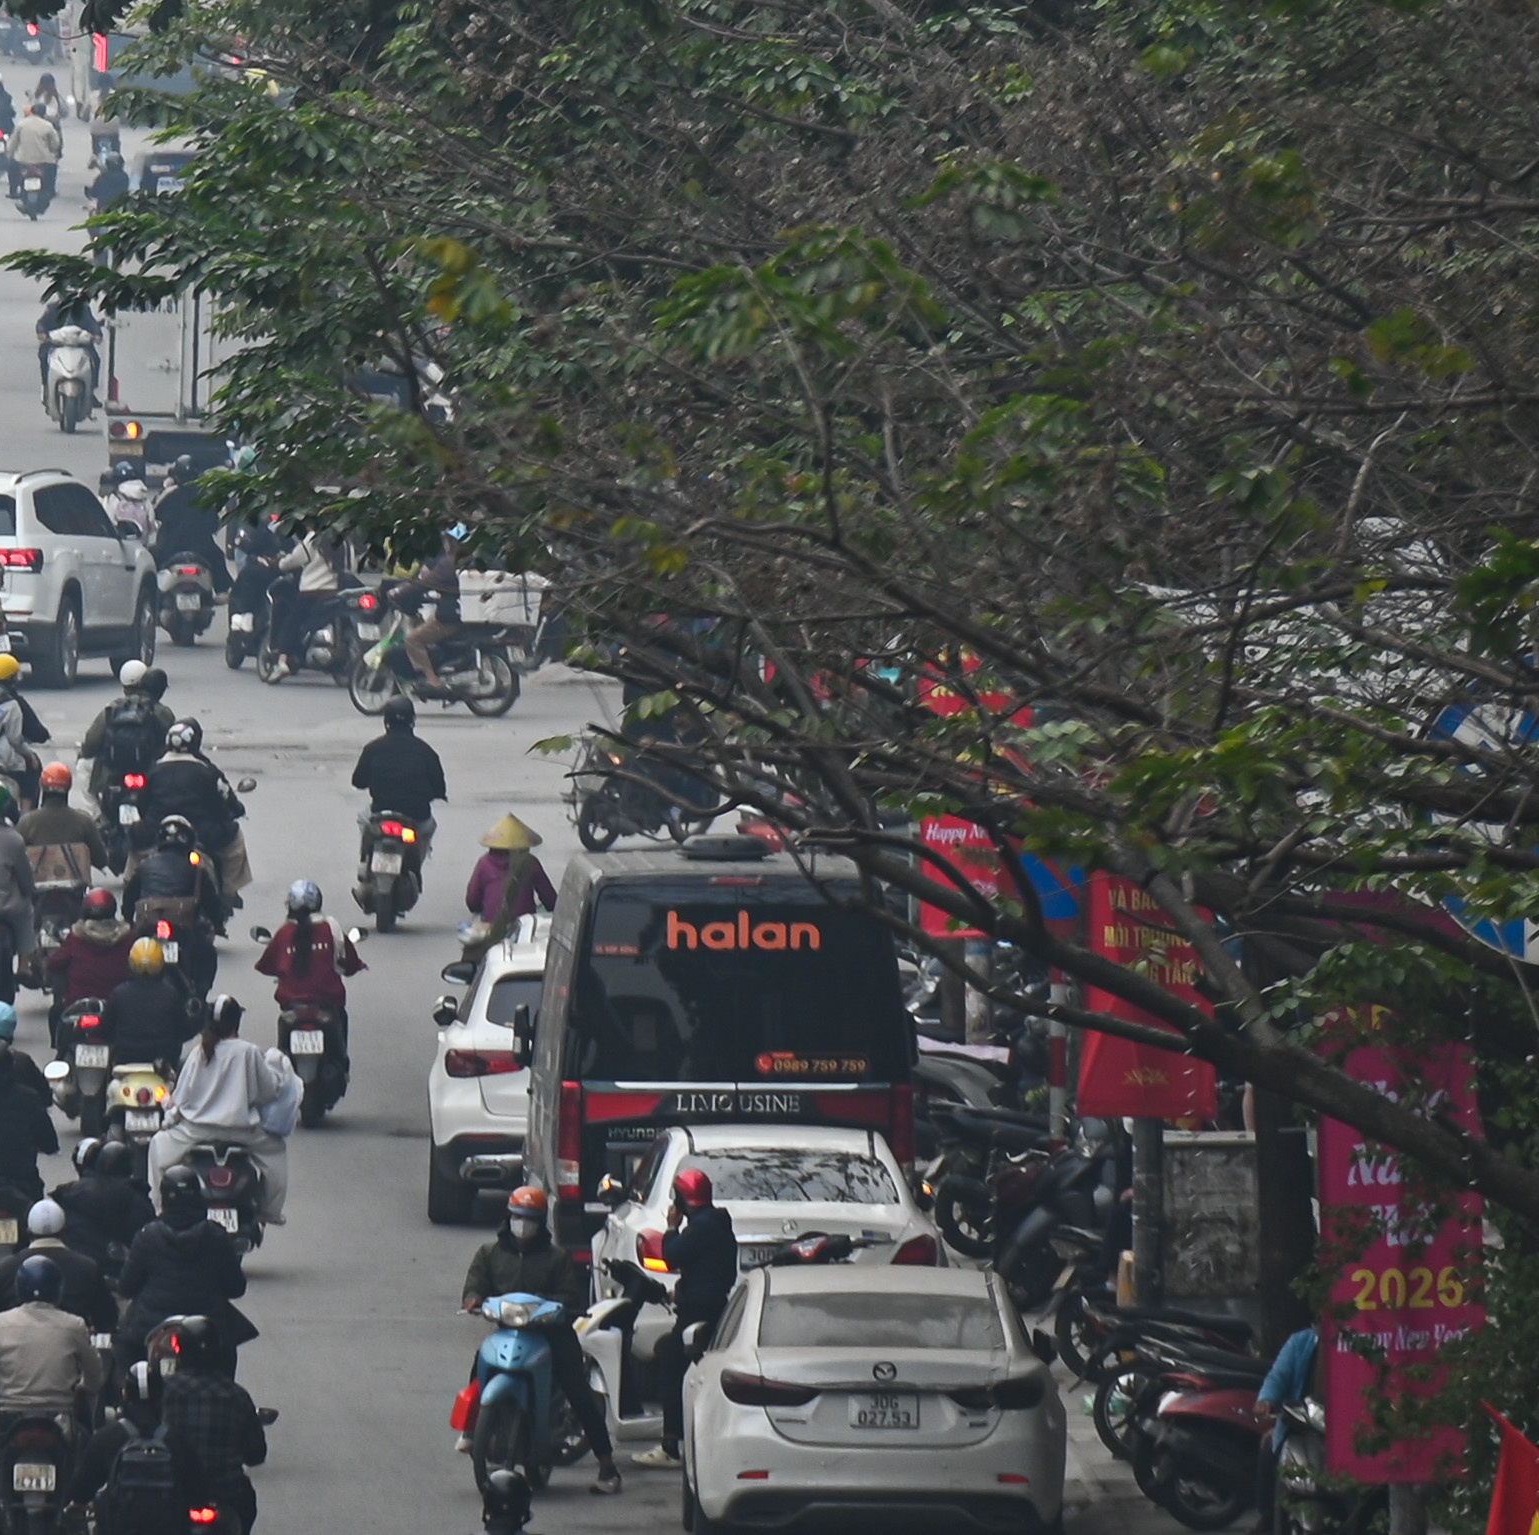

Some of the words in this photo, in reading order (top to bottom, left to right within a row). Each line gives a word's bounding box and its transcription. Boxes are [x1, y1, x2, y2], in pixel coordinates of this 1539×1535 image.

[926, 823, 967, 844] Happy
[667, 910, 821, 950] halan
[774, 1059, 809, 1072] 0989
[812, 1059, 837, 1072] 759
[841, 1059, 866, 1072] 759
[1351, 1266, 1465, 1311] 2026
[871, 1394, 899, 1410] 30G
[858, 1410, 911, 1425] 027.53
